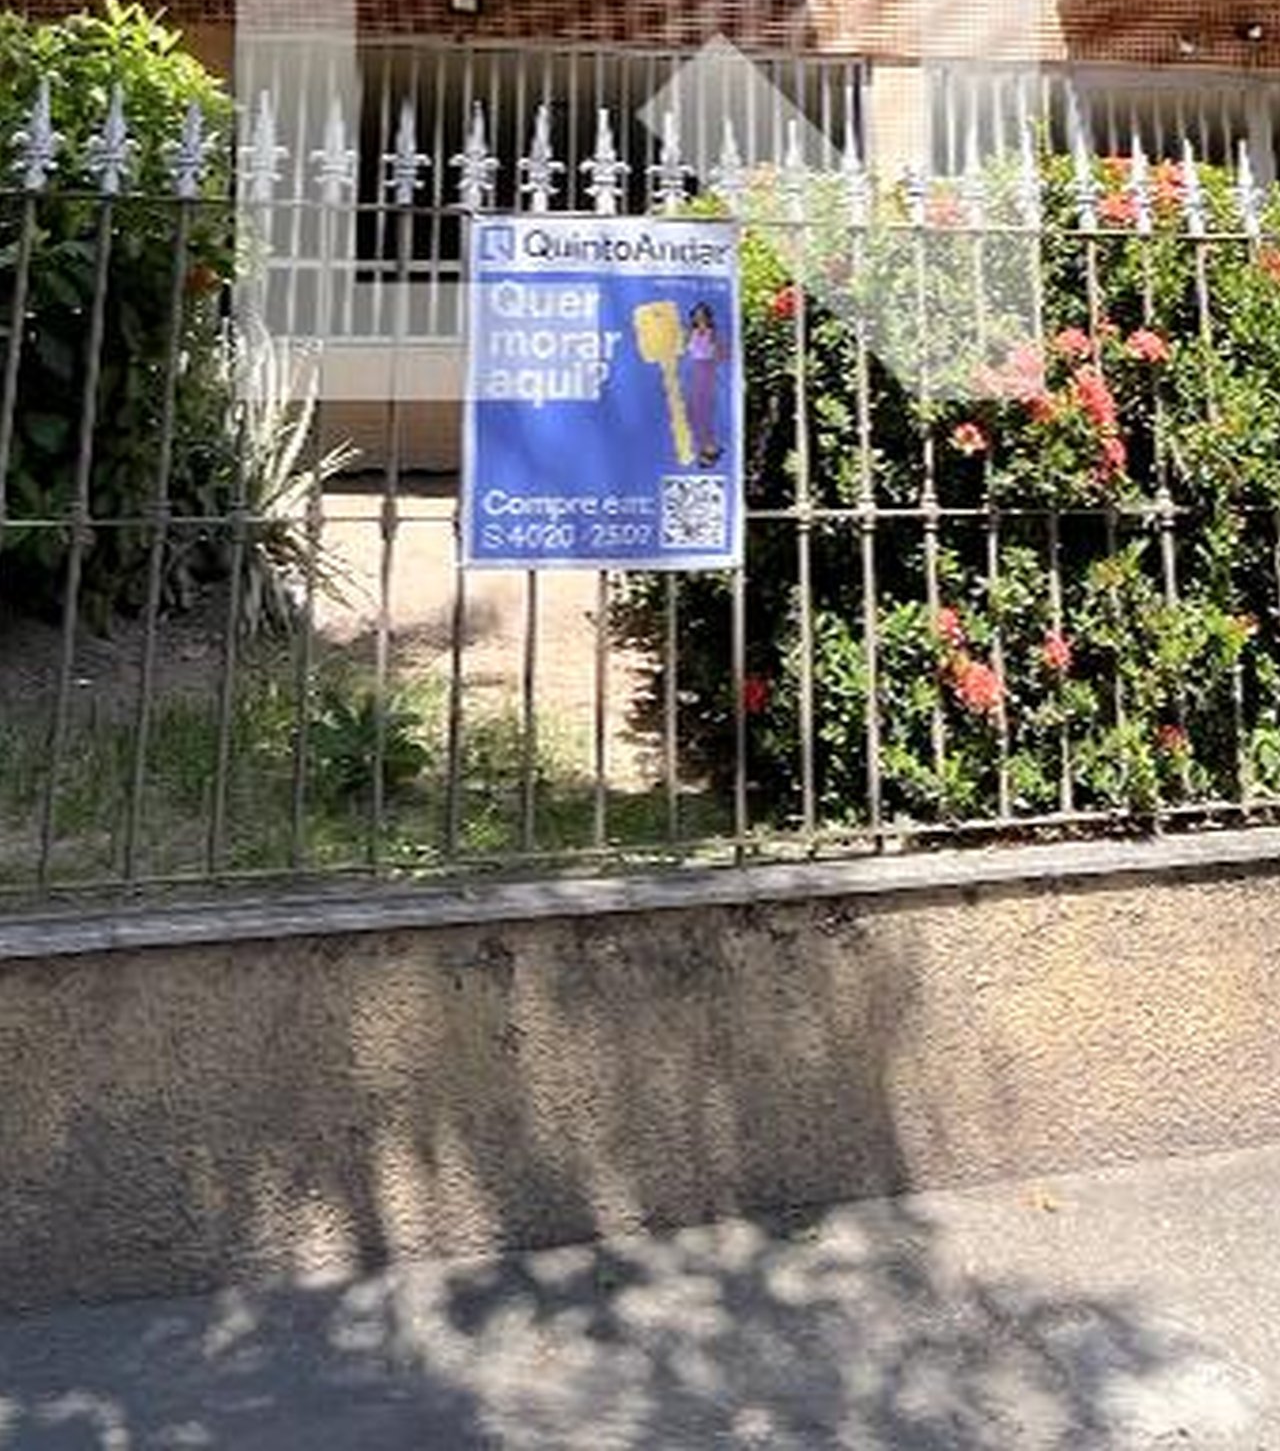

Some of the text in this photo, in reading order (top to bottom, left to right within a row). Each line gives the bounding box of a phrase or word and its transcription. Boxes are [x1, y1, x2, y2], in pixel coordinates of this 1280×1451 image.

[522, 229, 730, 265] QuintoAndar
[492, 280, 599, 317] Quer
[491, 330, 622, 360] morar
[490, 361, 609, 409] aqui?
[483, 489, 599, 520] Compre
